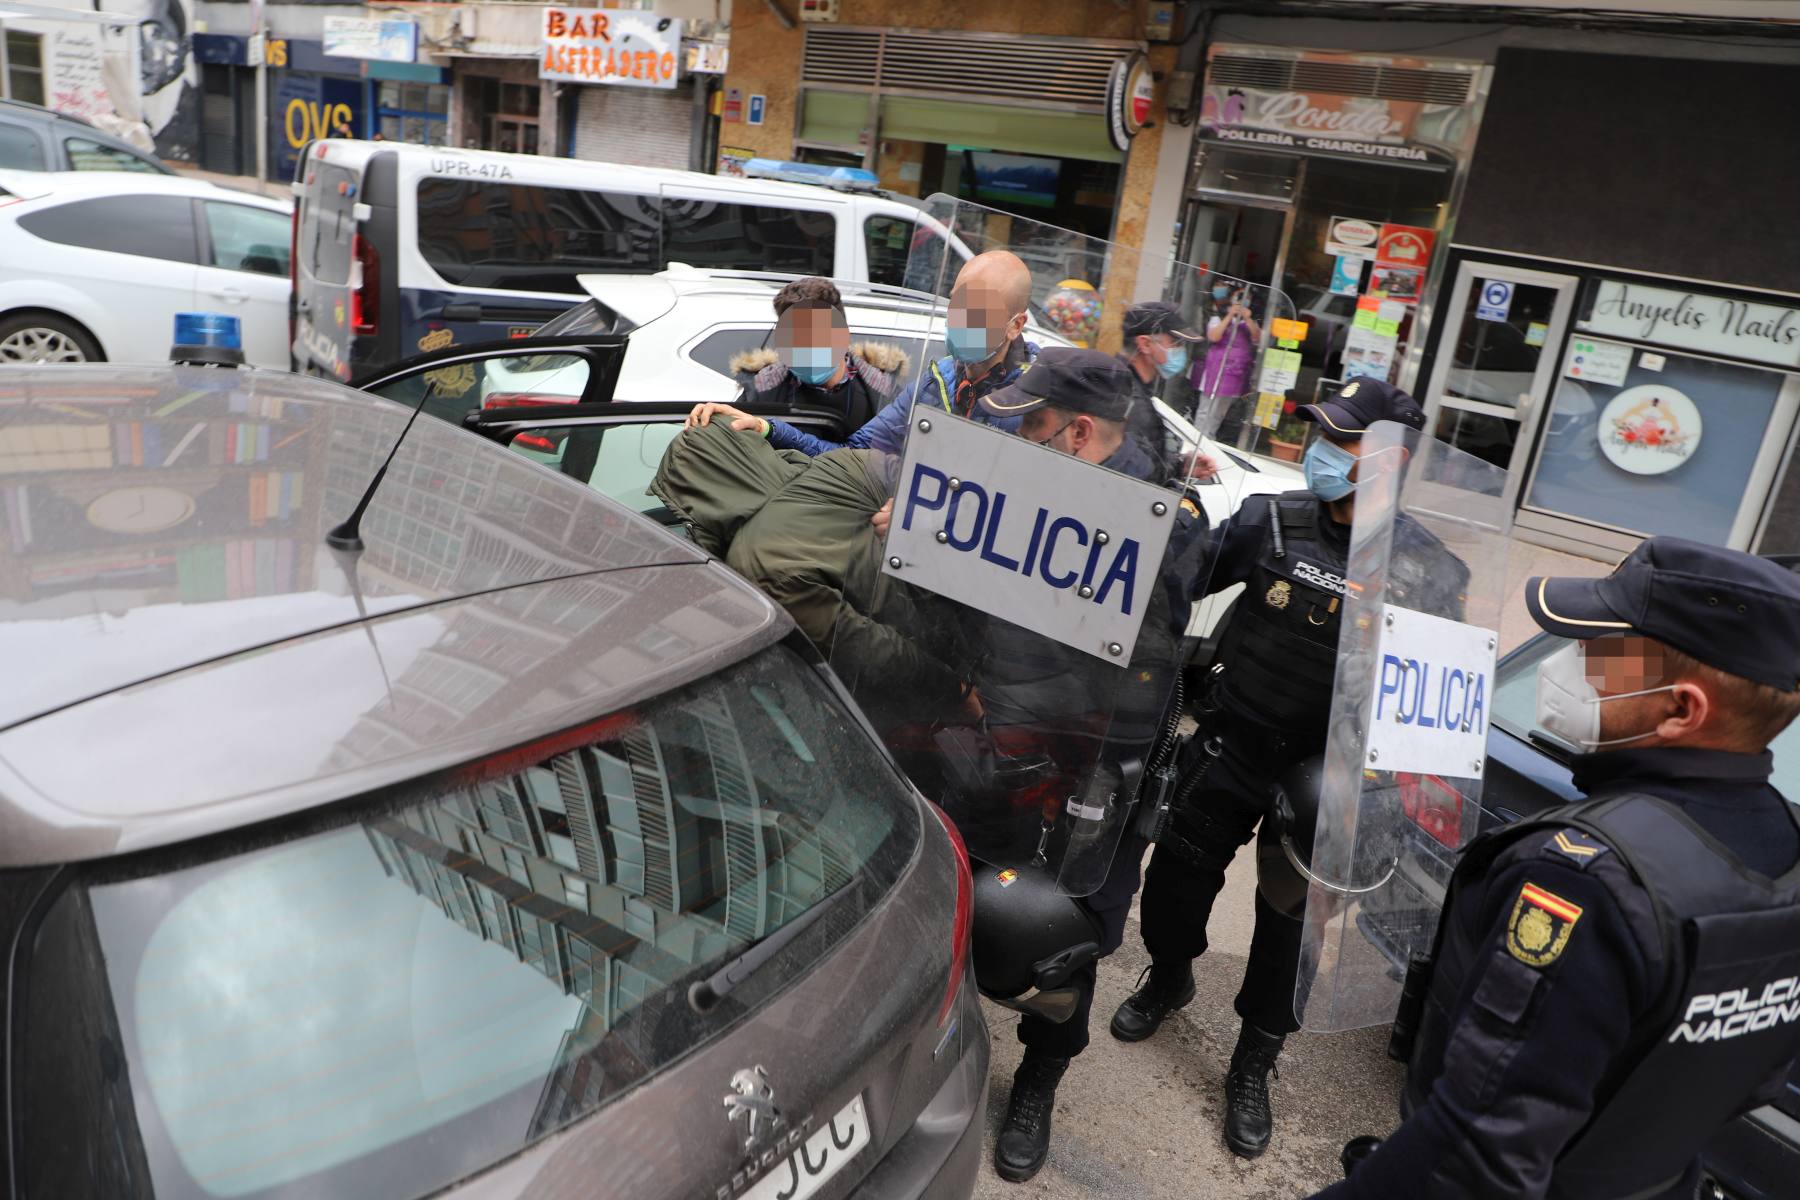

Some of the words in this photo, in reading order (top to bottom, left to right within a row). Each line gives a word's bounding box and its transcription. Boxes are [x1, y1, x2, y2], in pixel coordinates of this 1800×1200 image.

[547, 10, 611, 43] BAR
[543, 45, 675, 83] ASERRADERO
[1217, 128, 1294, 146] POLLERÍA
[1306, 137, 1428, 161] CHARCUTERÍA
[431, 158, 513, 179] UPR-47A
[1719, 300, 1799, 344] Nails
[901, 463, 1140, 616] POLICIA
[1376, 654, 1486, 735] POLICIA
